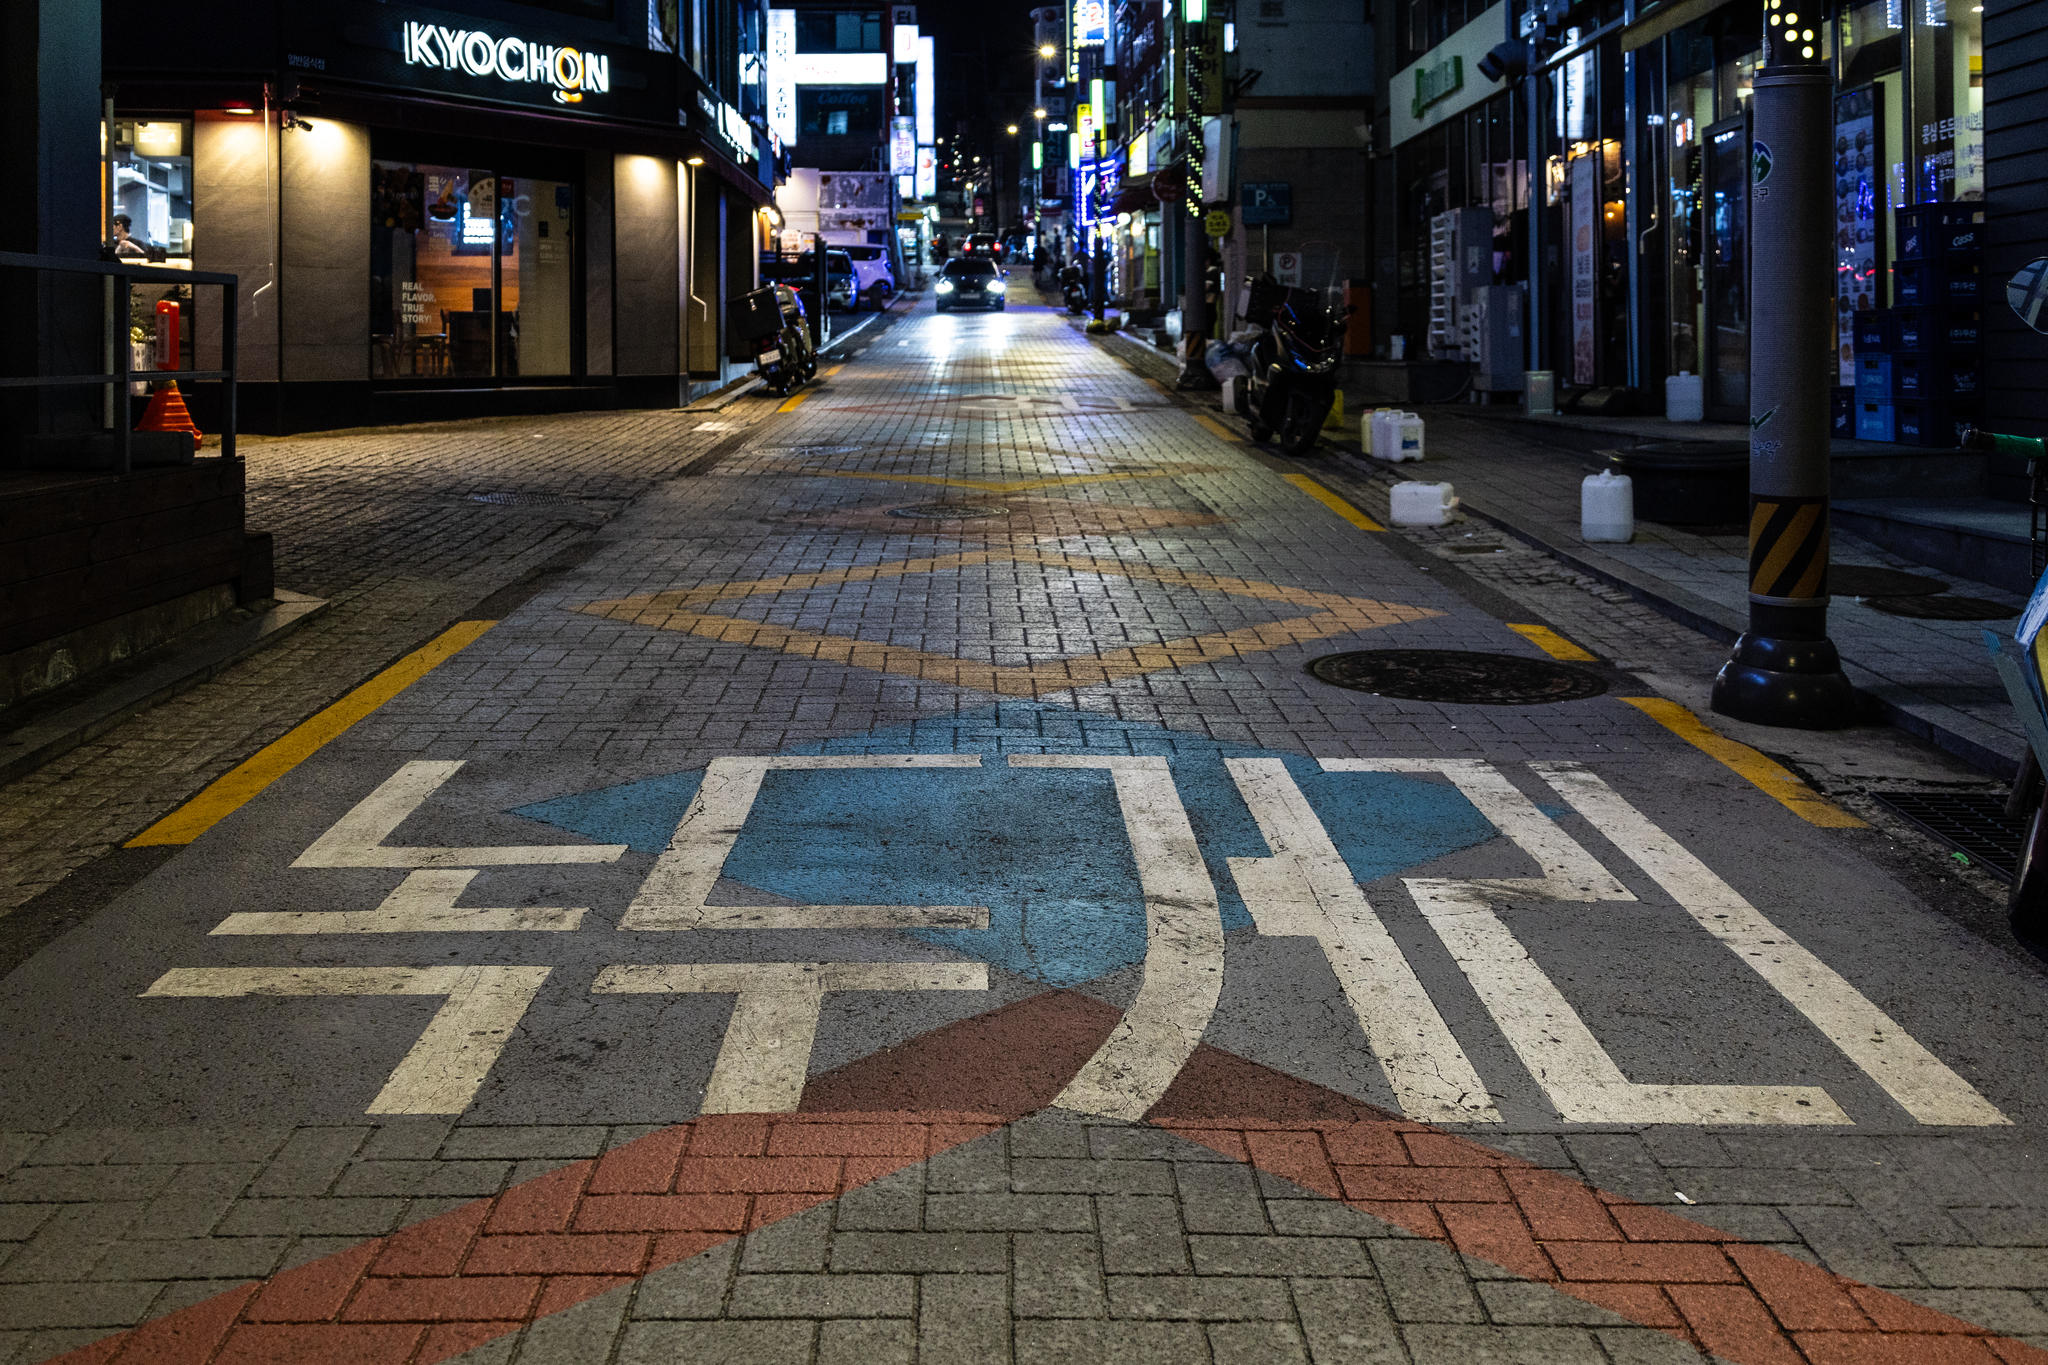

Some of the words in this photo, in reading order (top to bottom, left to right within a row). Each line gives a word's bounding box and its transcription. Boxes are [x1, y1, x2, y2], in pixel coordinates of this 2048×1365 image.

[404, 20, 610, 94] KYOCHON
[817, 91, 869, 105] Coffee
[1255, 189, 1267, 207] P
[1952, 231, 1975, 247] Cass
[401, 281, 424, 291] REAL
[401, 303, 425, 313] TRUE
[401, 313, 432, 324] STORY!
[138, 755, 2012, 1127] 녹두거리
